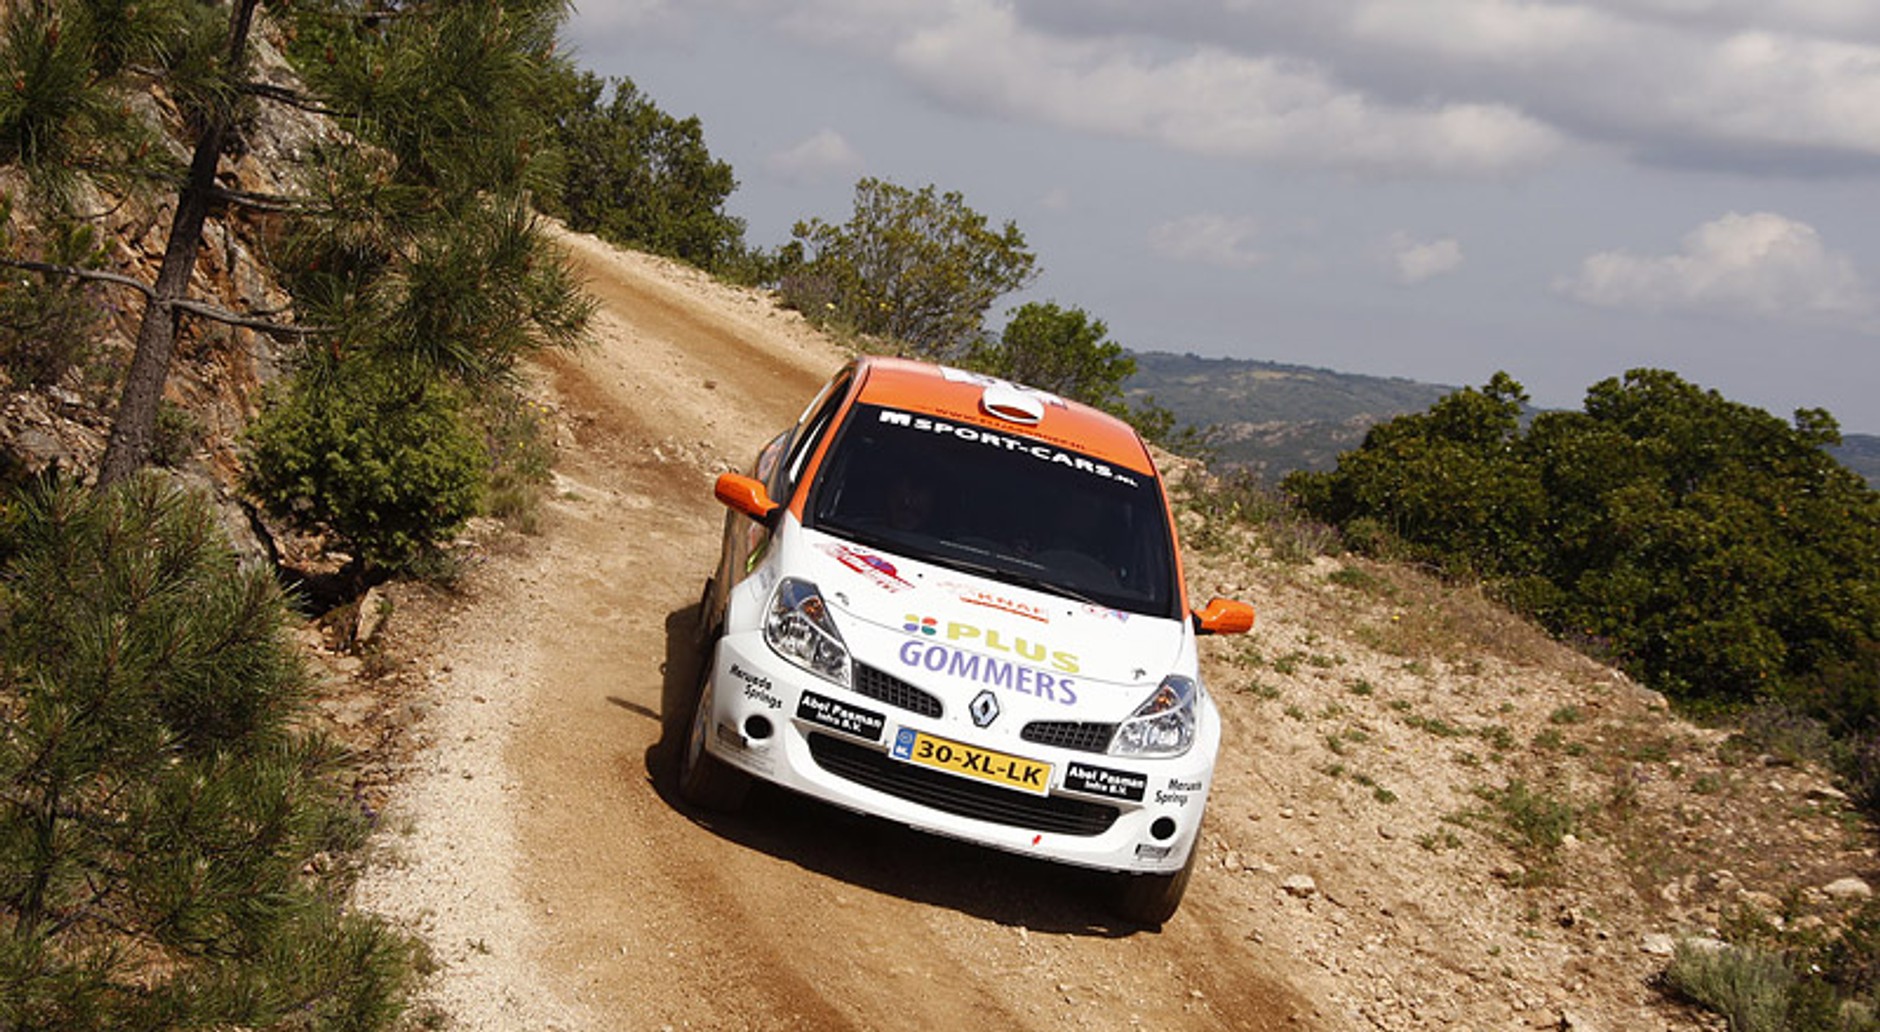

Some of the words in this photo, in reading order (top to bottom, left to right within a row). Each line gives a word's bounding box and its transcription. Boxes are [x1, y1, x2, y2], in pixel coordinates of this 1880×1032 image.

[946, 621, 1080, 674] PLUS
[899, 640, 1078, 706] GOMMERS
[744, 684, 783, 710] Springs
[801, 695, 831, 713] Abel
[917, 740, 1043, 786] 30-XL-LK
